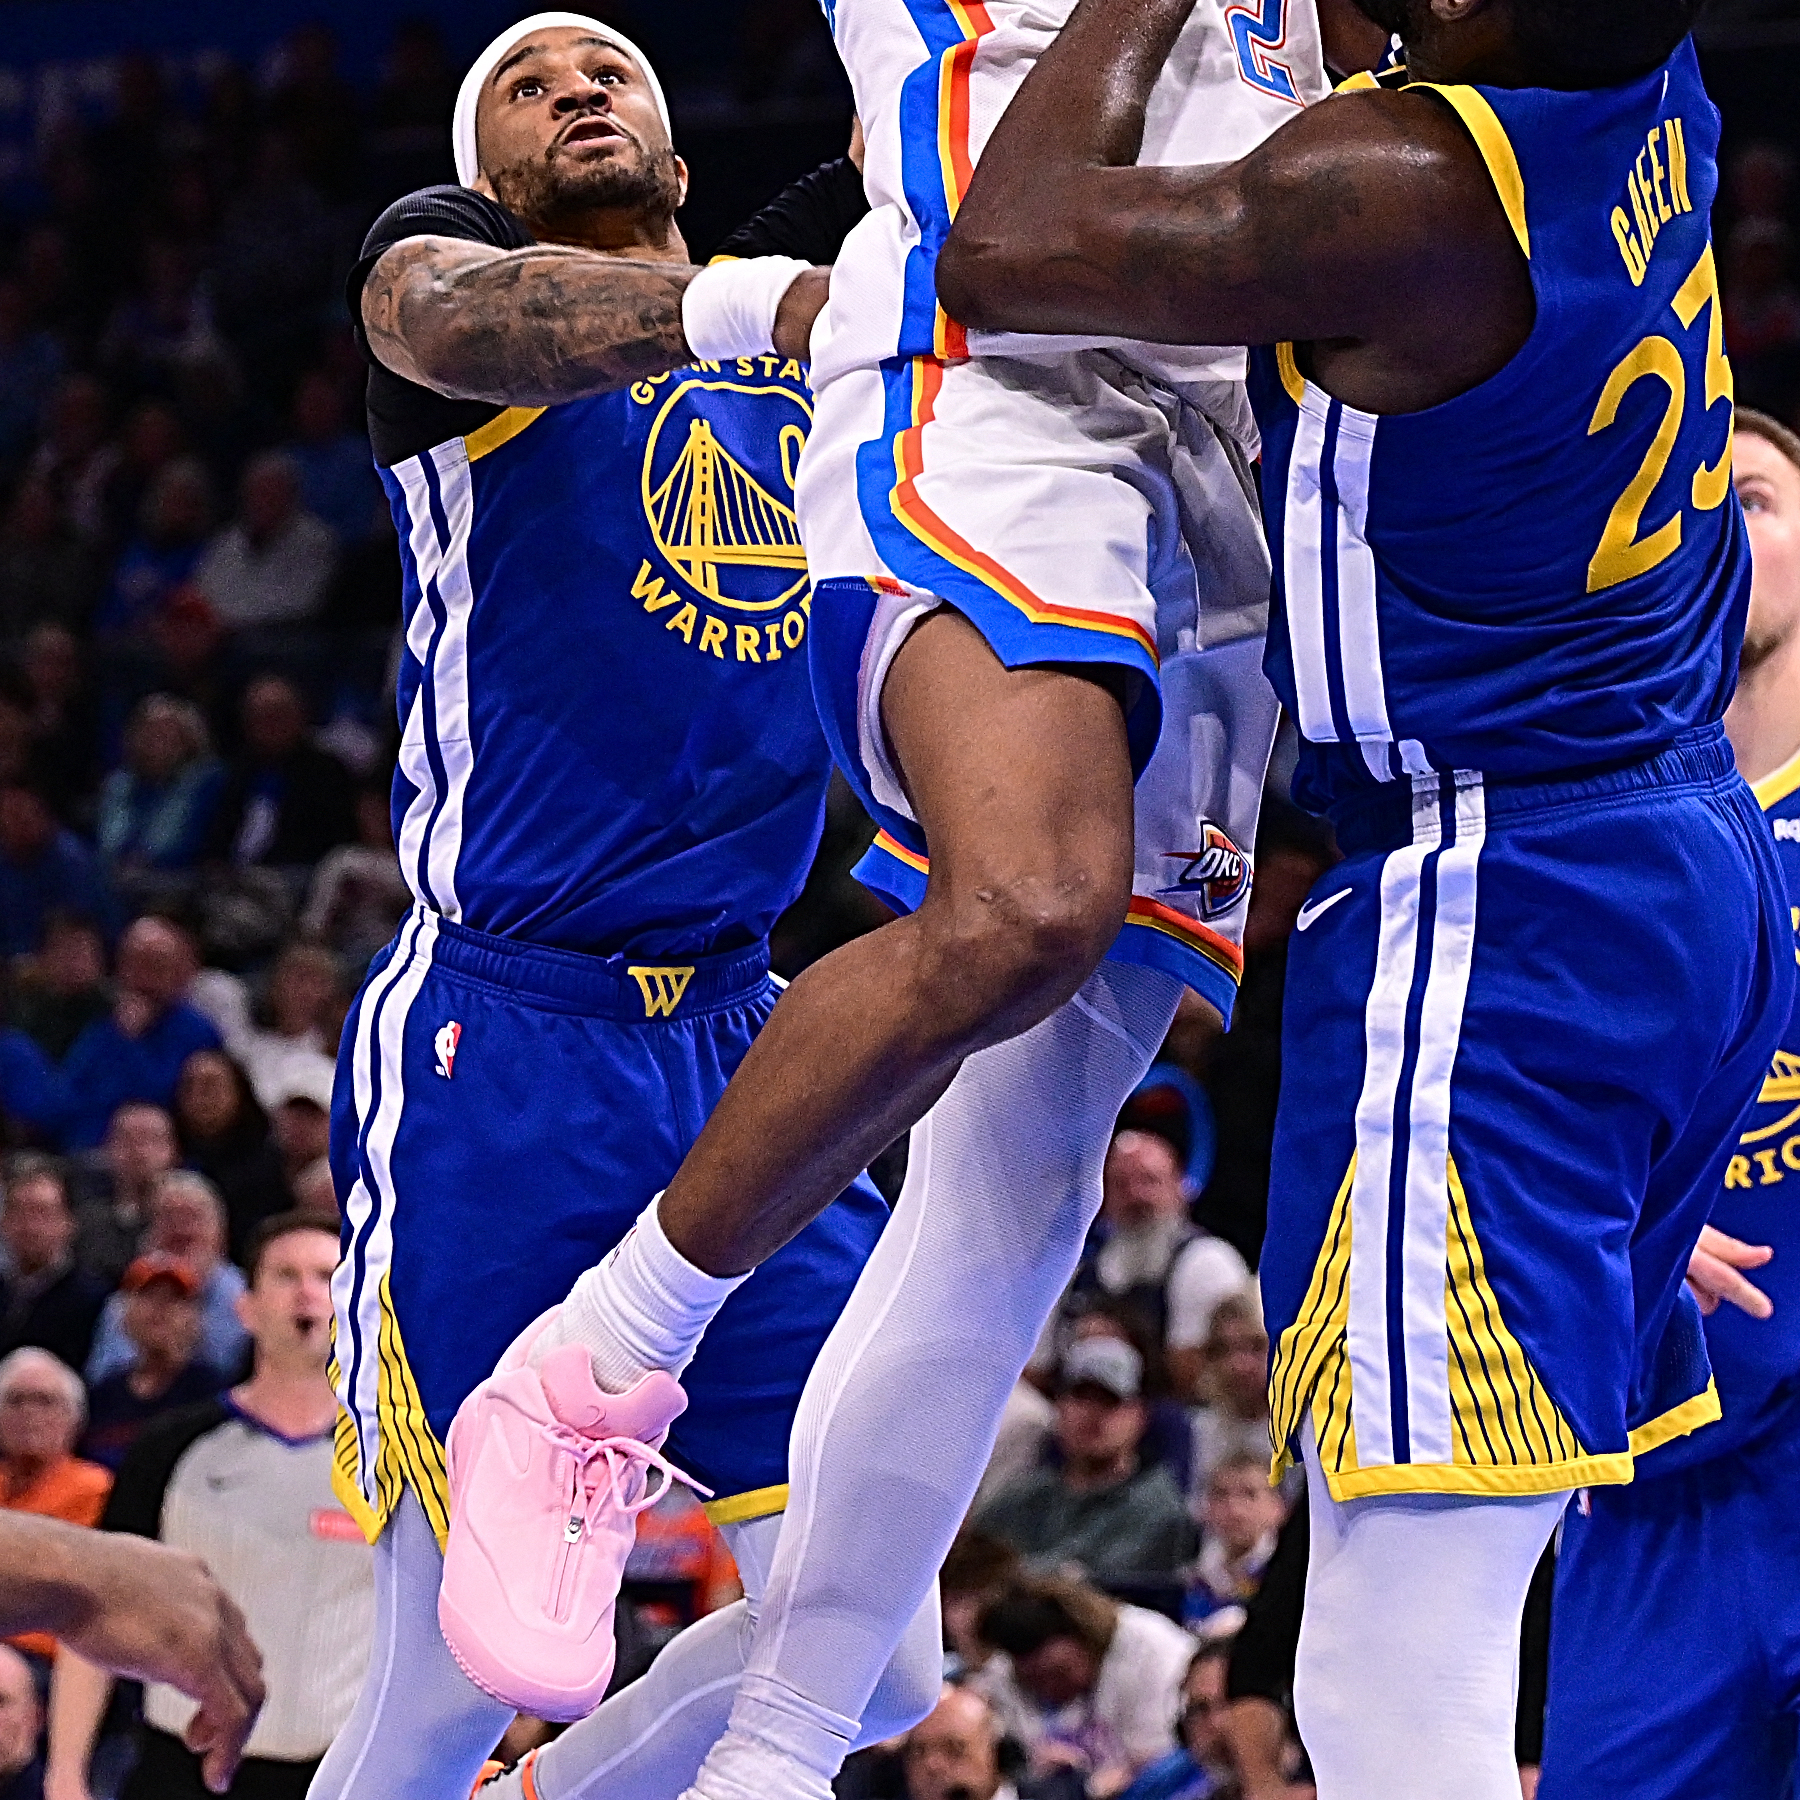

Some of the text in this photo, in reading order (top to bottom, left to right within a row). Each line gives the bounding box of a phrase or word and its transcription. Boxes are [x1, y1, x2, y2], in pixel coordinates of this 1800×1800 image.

[1611, 117, 1693, 287] GREEN
[736, 355, 817, 402] STA
[1587, 240, 1734, 593] 23
[630, 559, 812, 663] WARRIO
[1184, 846, 1240, 881] OKC
